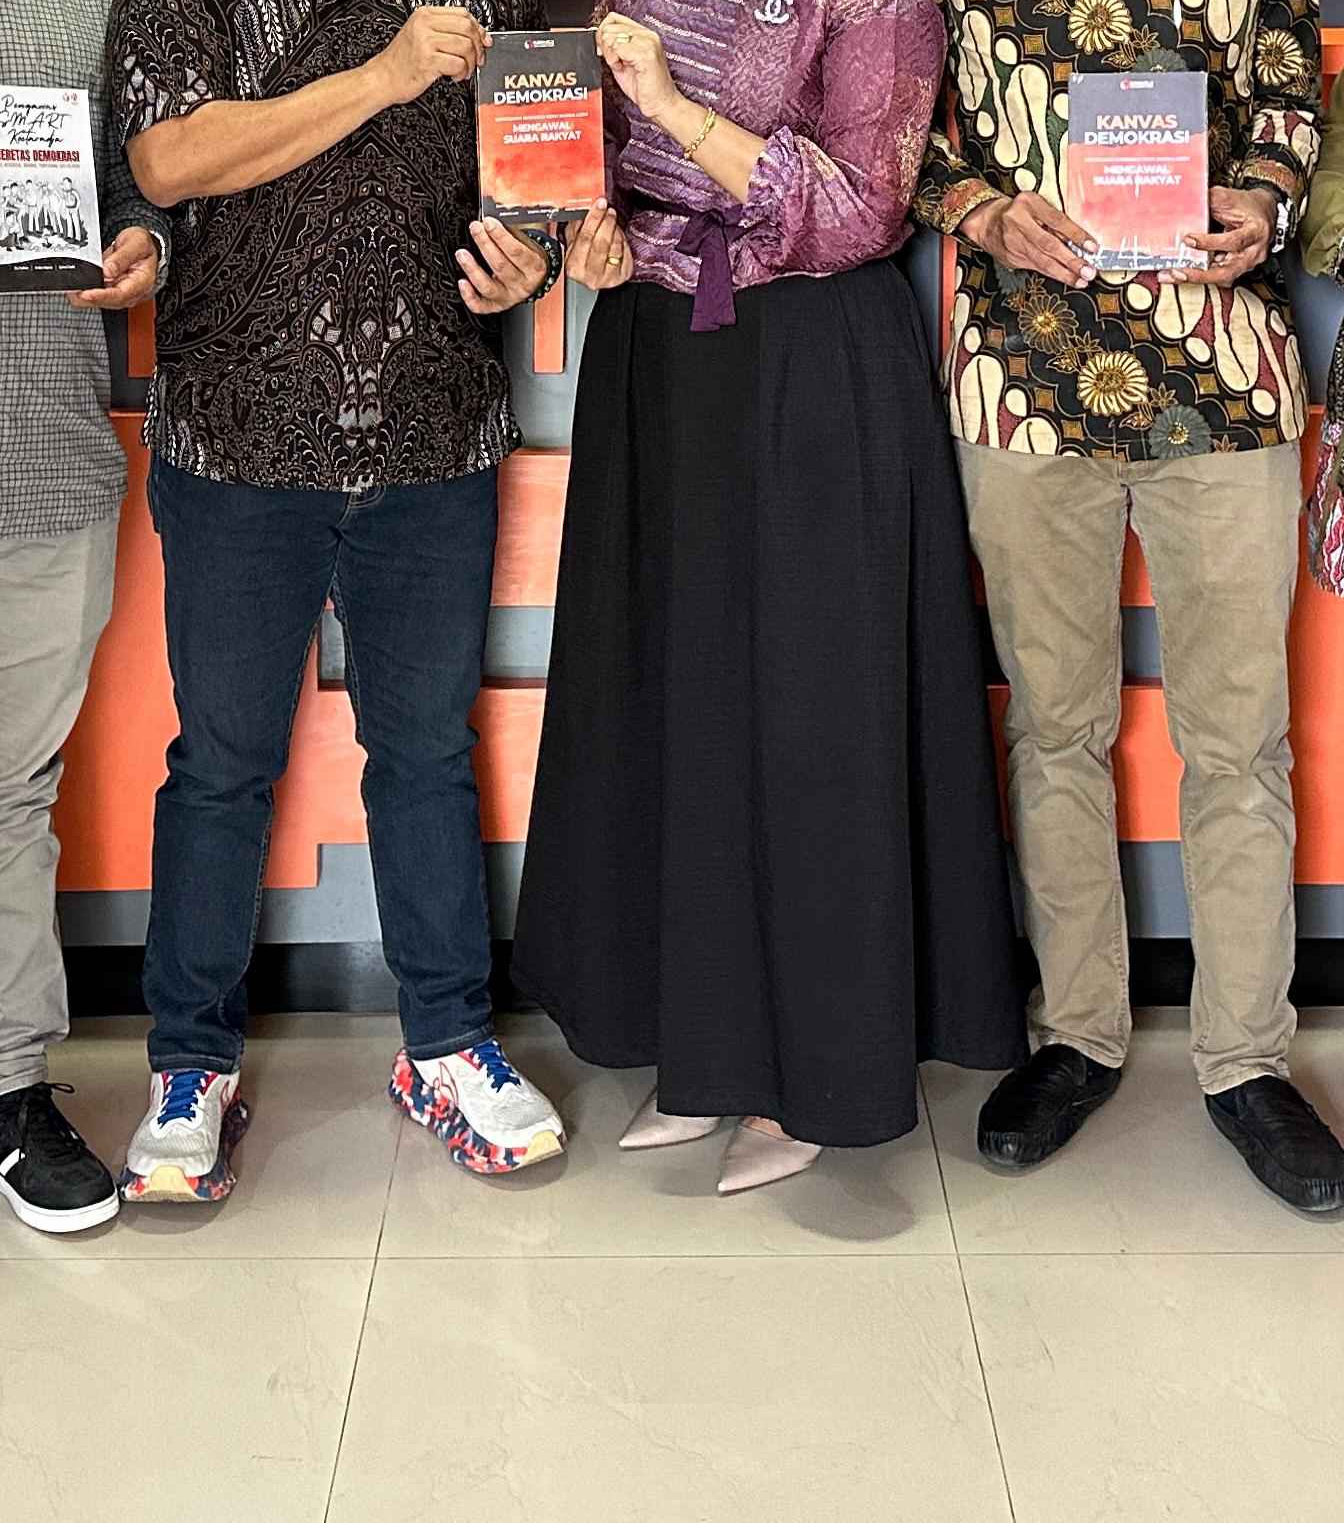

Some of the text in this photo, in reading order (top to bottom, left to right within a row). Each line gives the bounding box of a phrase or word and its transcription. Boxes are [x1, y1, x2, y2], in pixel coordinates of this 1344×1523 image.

[504, 71, 577, 90] KANVAS
[493, 87, 589, 105] DEMOKRASI
[1096, 114, 1178, 131] KANVAS
[1084, 130, 1190, 146] DEMOKRASI
